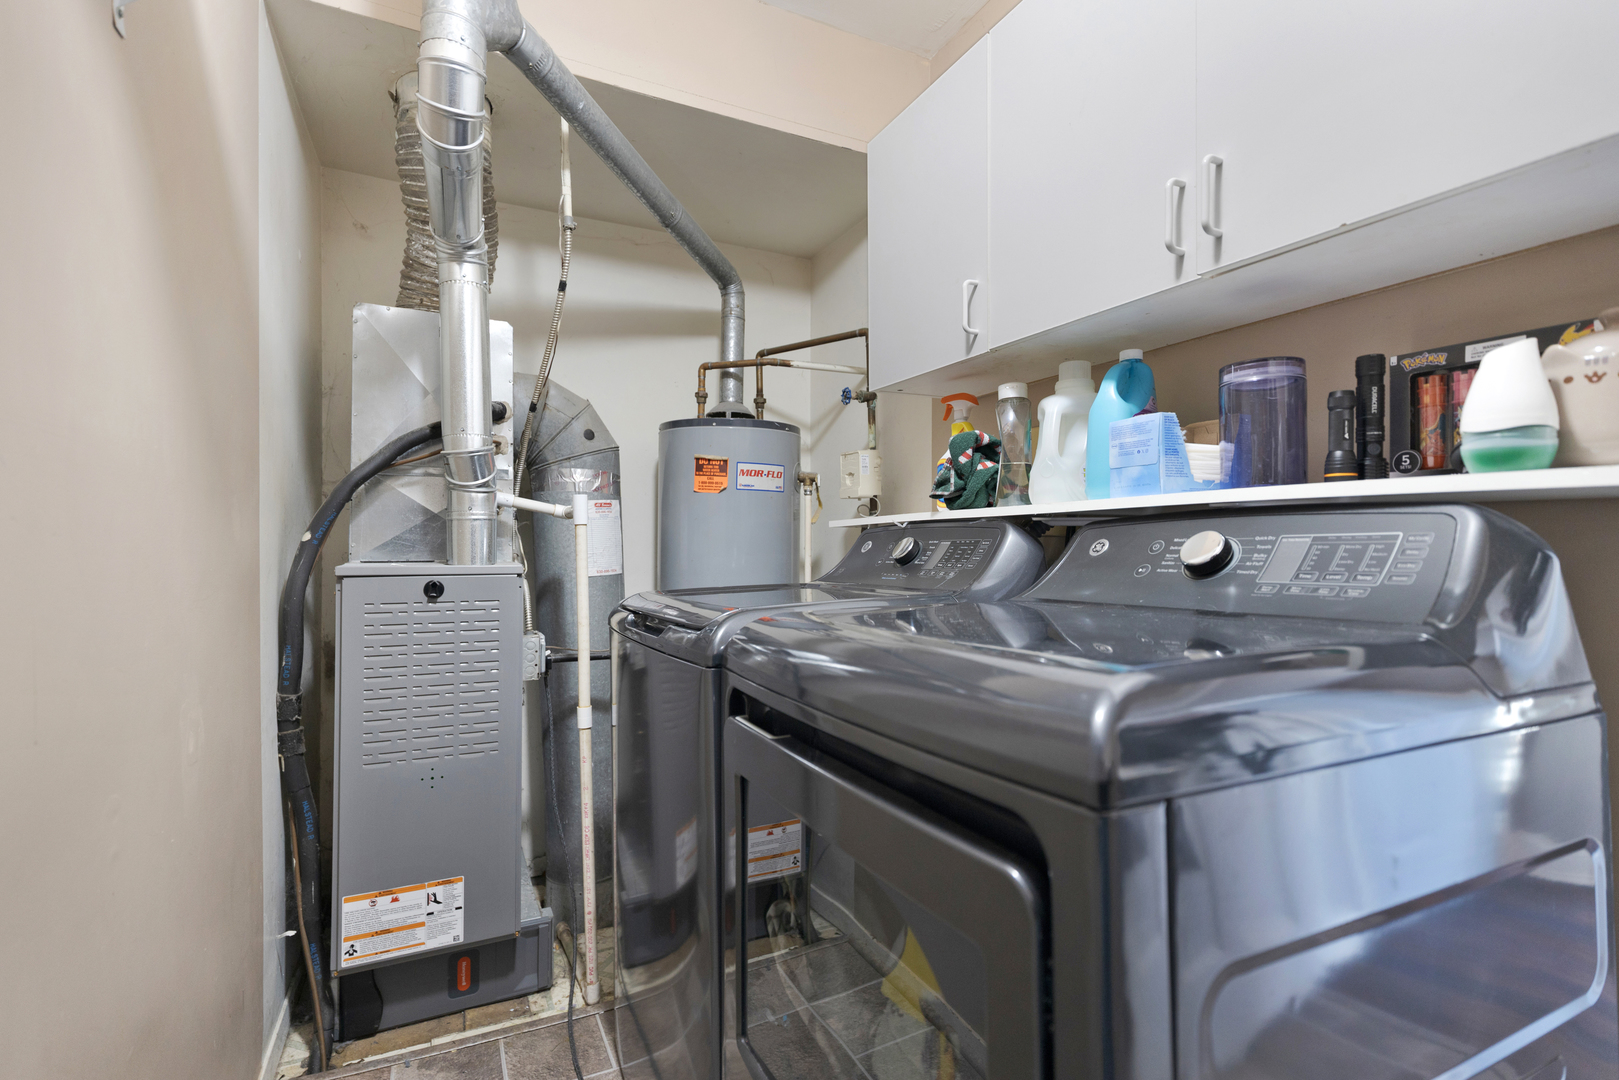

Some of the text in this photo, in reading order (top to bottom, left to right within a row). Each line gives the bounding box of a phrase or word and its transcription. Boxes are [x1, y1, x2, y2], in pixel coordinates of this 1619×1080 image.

[1401, 454, 1411, 466] 5
[283, 644, 291, 678] HALSTEAD
[302, 800, 314, 834] HALSTEAD
